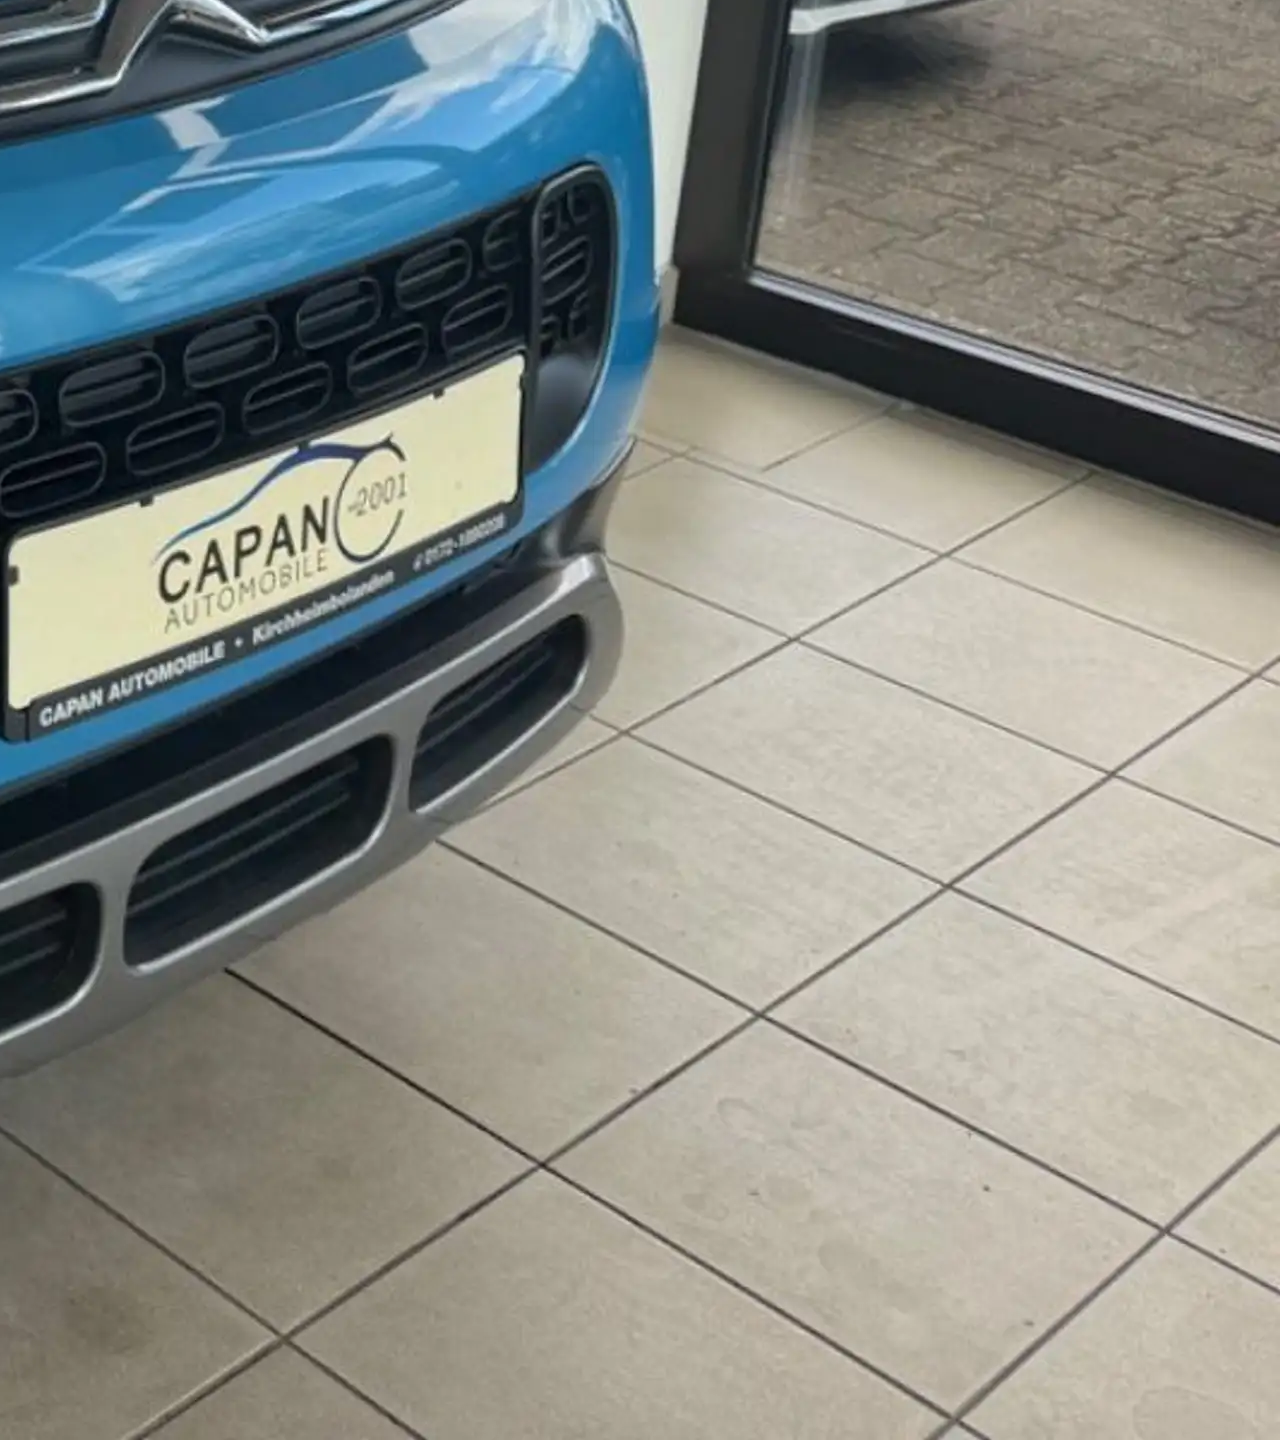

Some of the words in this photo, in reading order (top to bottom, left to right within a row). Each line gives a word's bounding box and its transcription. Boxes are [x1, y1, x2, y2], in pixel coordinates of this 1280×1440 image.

[158, 495, 329, 603] CAPAN
[164, 548, 329, 633] AUTOMOBILE
[39, 687, 104, 728] CAPAN
[107, 640, 226, 702] AUTOMOBILE
[252, 569, 395, 645] Kirchheimbolanden
